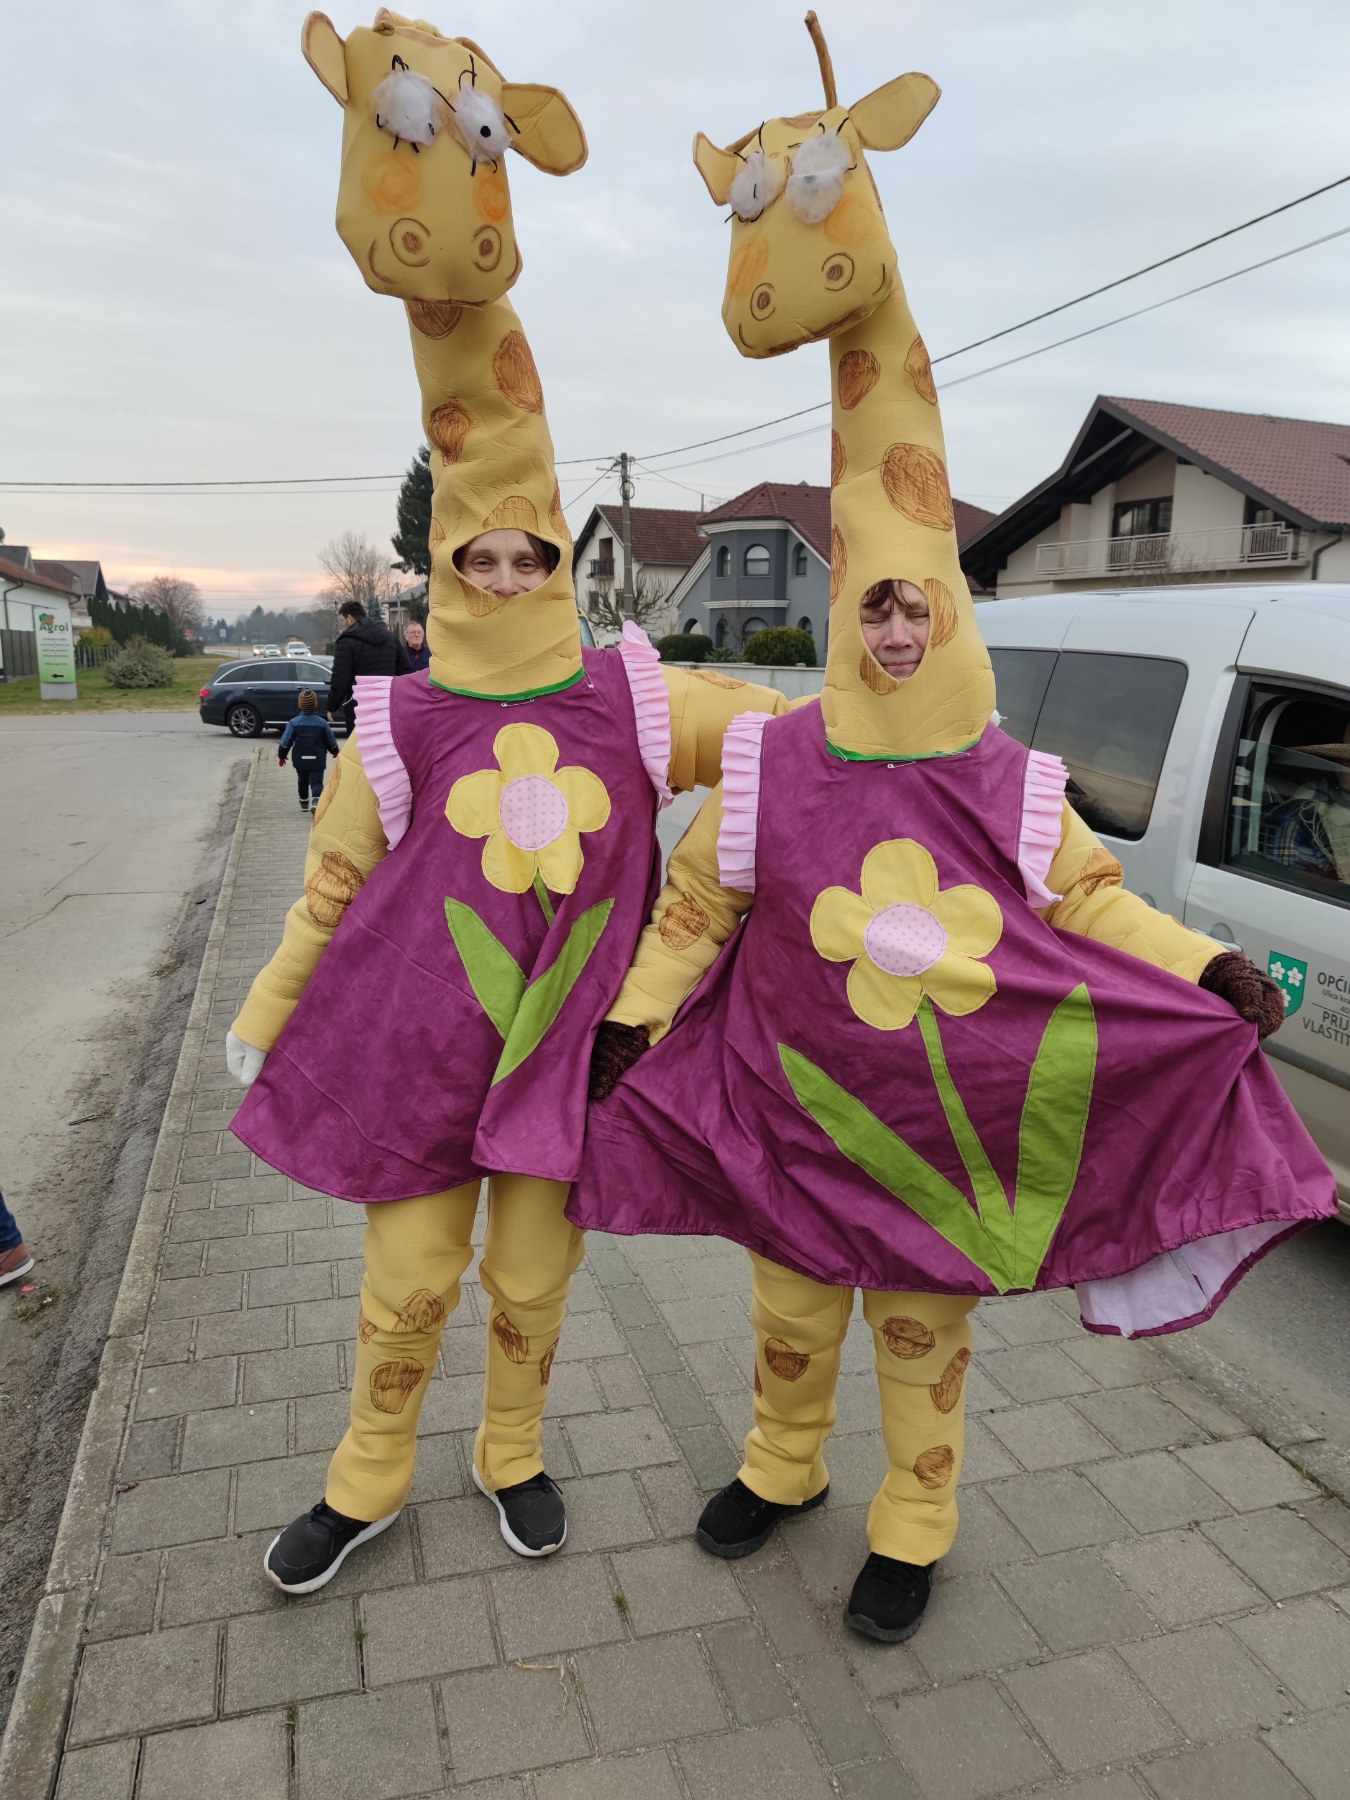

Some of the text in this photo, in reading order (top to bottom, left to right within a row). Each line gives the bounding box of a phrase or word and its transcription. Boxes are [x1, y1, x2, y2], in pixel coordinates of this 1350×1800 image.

[39, 622, 69, 634] Agrol
[1317, 972, 1350, 995] OPĆI
[1322, 988, 1339, 1001] Ulica
